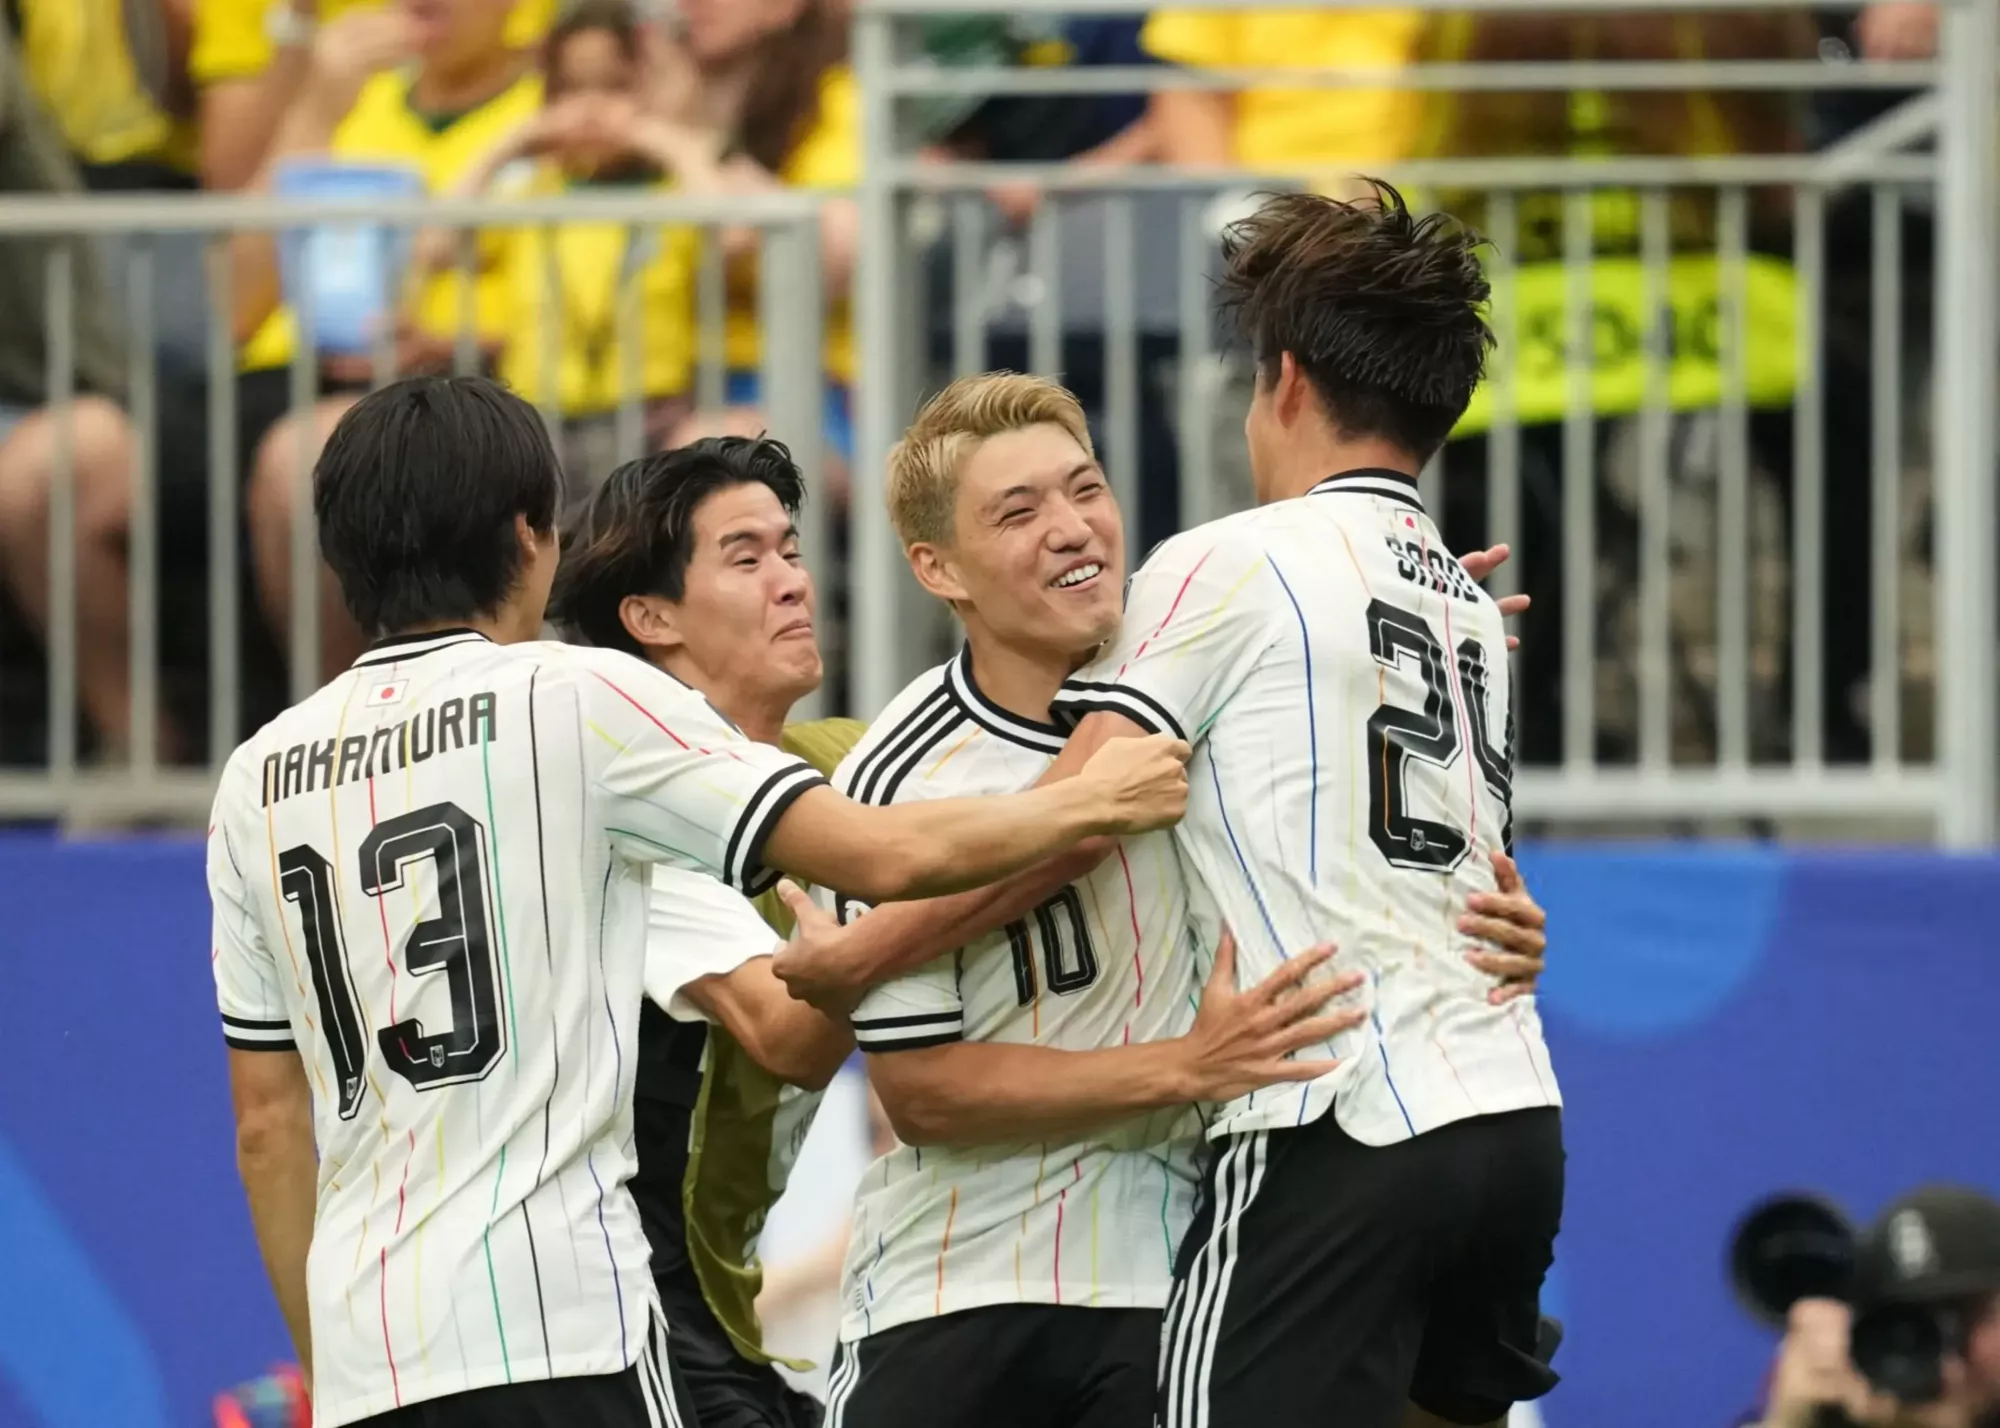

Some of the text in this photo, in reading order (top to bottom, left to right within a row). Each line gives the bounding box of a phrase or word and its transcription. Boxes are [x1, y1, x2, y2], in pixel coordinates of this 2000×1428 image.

[262, 691, 496, 808] NAKAMURA
[279, 801, 507, 1121] 13
[1004, 882, 1100, 1008] 10
